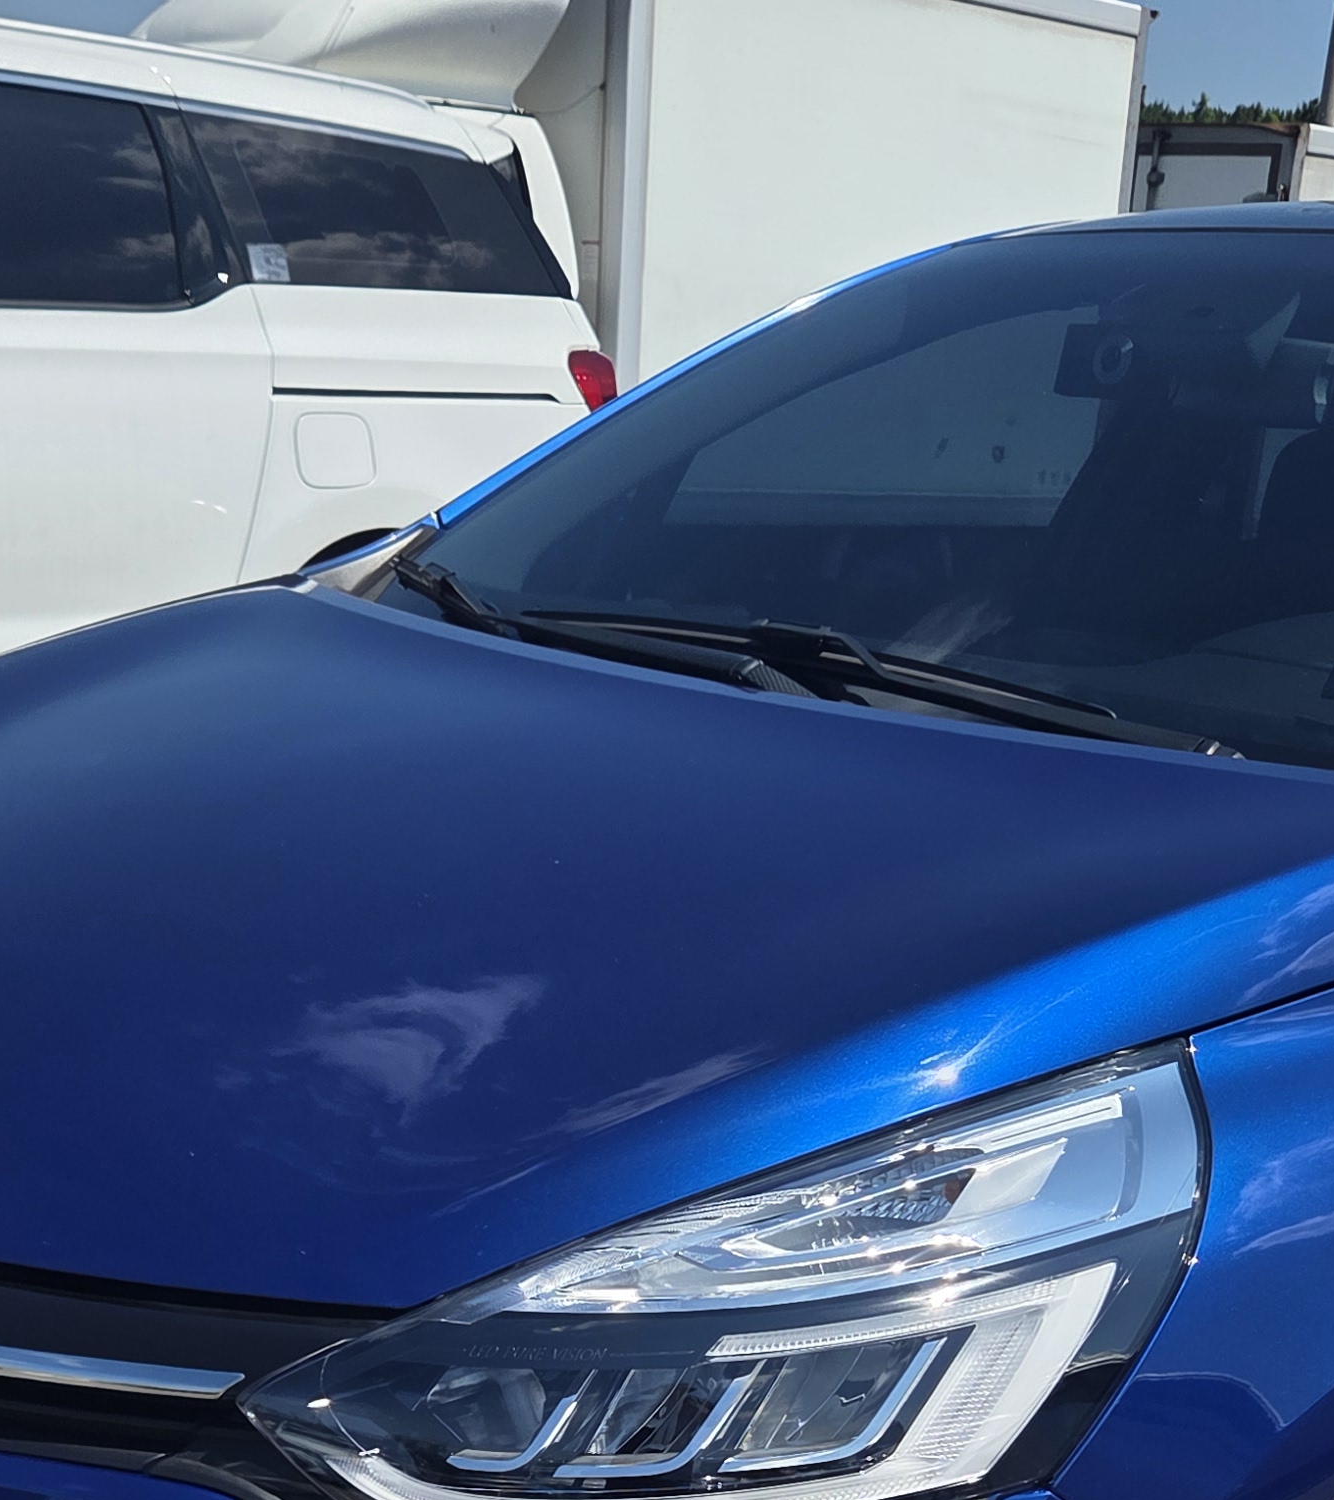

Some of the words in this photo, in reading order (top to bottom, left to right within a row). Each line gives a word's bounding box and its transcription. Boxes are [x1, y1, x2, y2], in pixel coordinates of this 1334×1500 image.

[469, 1345, 500, 1359] LED
[503, 1346, 547, 1361] PURE
[551, 1347, 608, 1362] VISION
